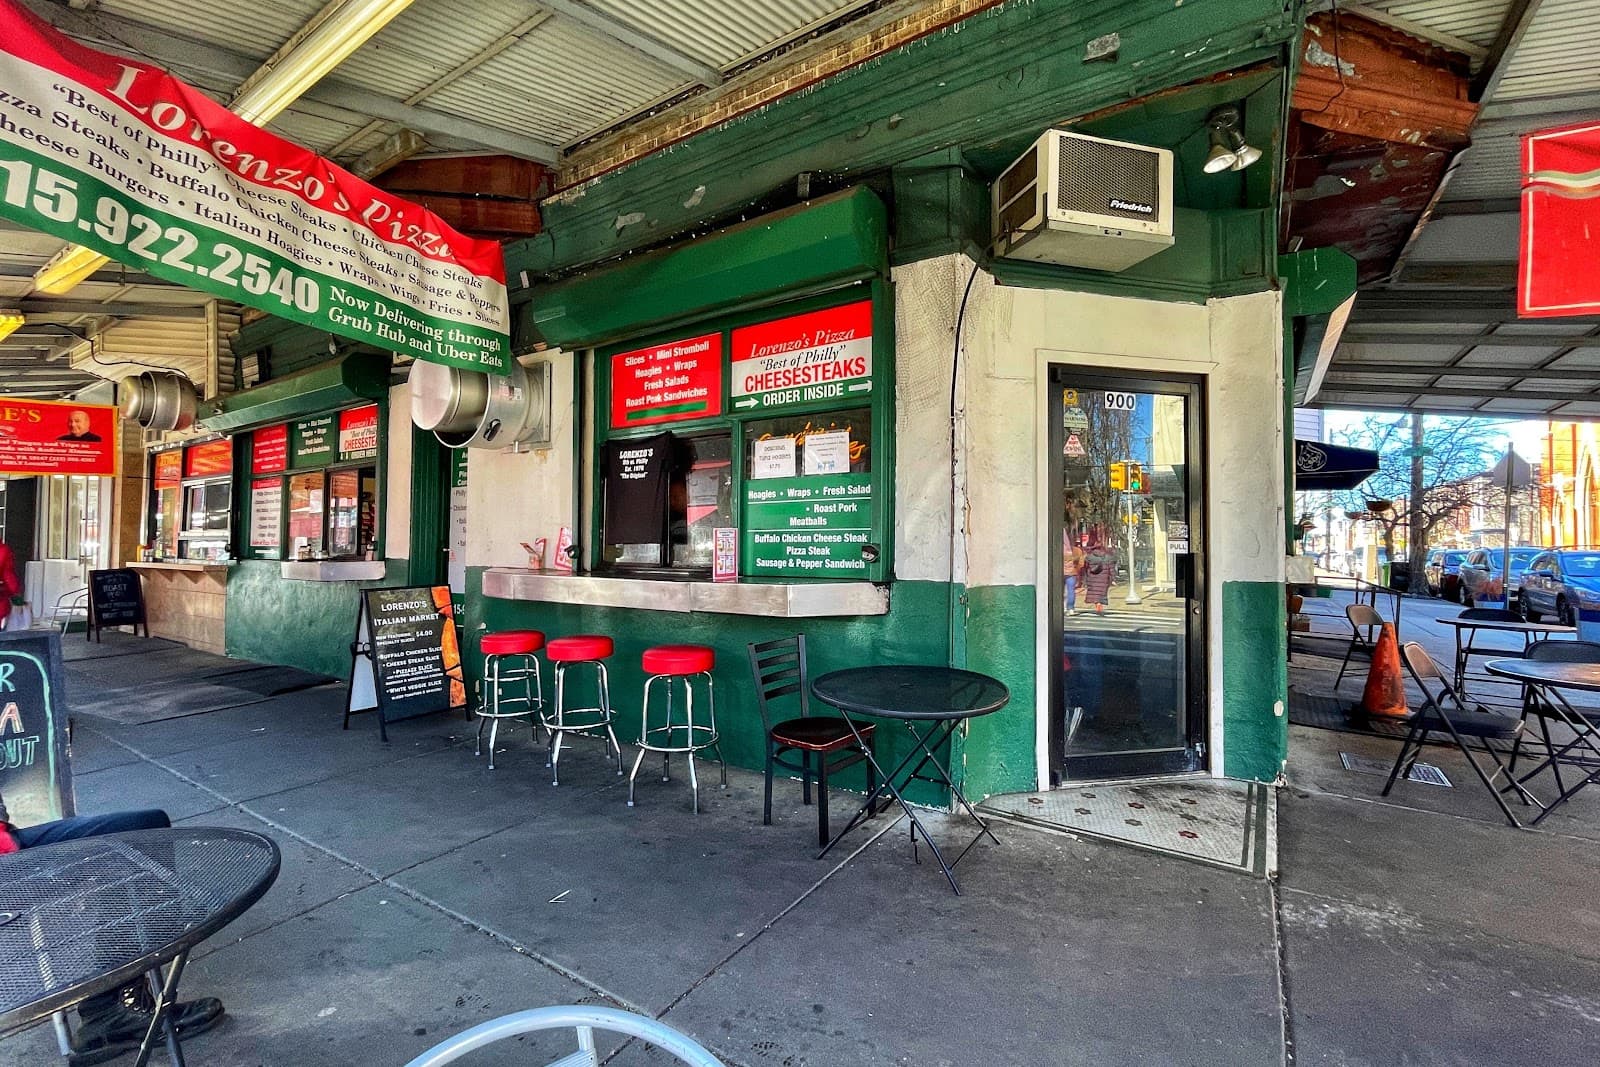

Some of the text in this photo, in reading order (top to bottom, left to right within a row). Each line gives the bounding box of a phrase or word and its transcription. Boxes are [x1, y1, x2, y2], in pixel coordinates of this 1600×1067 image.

[106, 63, 350, 212] Lorenzo's
[53, 83, 483, 289] “Best of Philly” Cheese Steaks Chicken Cheese Steaks
[52, 111, 130, 160] Steaks
[150, 162, 230, 202] Buffalo
[236, 197, 298, 236] Chicken
[302, 230, 356, 257] Cheese
[360, 251, 398, 277] Steaks
[409, 272, 451, 298] Sausage
[456, 289, 466, 300] &
[1110, 200, 1152, 213] Friedrich
[88, 149, 169, 205] Burgers
[194, 202, 261, 237] Italian
[267, 230, 322, 265] Hoagies
[339, 261, 379, 287] Wraps
[429, 300, 463, 316] Fries
[330, 286, 501, 351] Now Delivering through
[328, 306, 503, 367] Grub Hub and Uber Eats
[750, 328, 855, 359] Lorenzo's Pizza
[625, 341, 710, 366] Slices Mini Stromboli
[760, 344, 847, 371] “Best of Philly”
[635, 359, 697, 378] Hoagies Wraps
[745, 356, 866, 393] CHEESESTEAKS
[644, 375, 689, 390] Fresh Salads
[626, 396, 645, 407] Roast
[664, 387, 708, 401] Sandwiches
[763, 383, 844, 407] ORDER INSIDE
[1106, 393, 1135, 409] 900
[0, 407, 41, 422] E'S
[748, 484, 871, 500] Hoagies Wraps Fresh Salad
[813, 502, 858, 513] Roast Pork
[789, 517, 827, 526] Meatballs
[754, 532, 868, 543] Buffalo Chicken Cheese Steak
[786, 545, 831, 555] Pizza Steak
[756, 557, 865, 570] Sausage & Pepper Sandwich
[381, 600, 427, 611] LORENZO'S
[374, 613, 439, 626] ITALIAN MARKET
